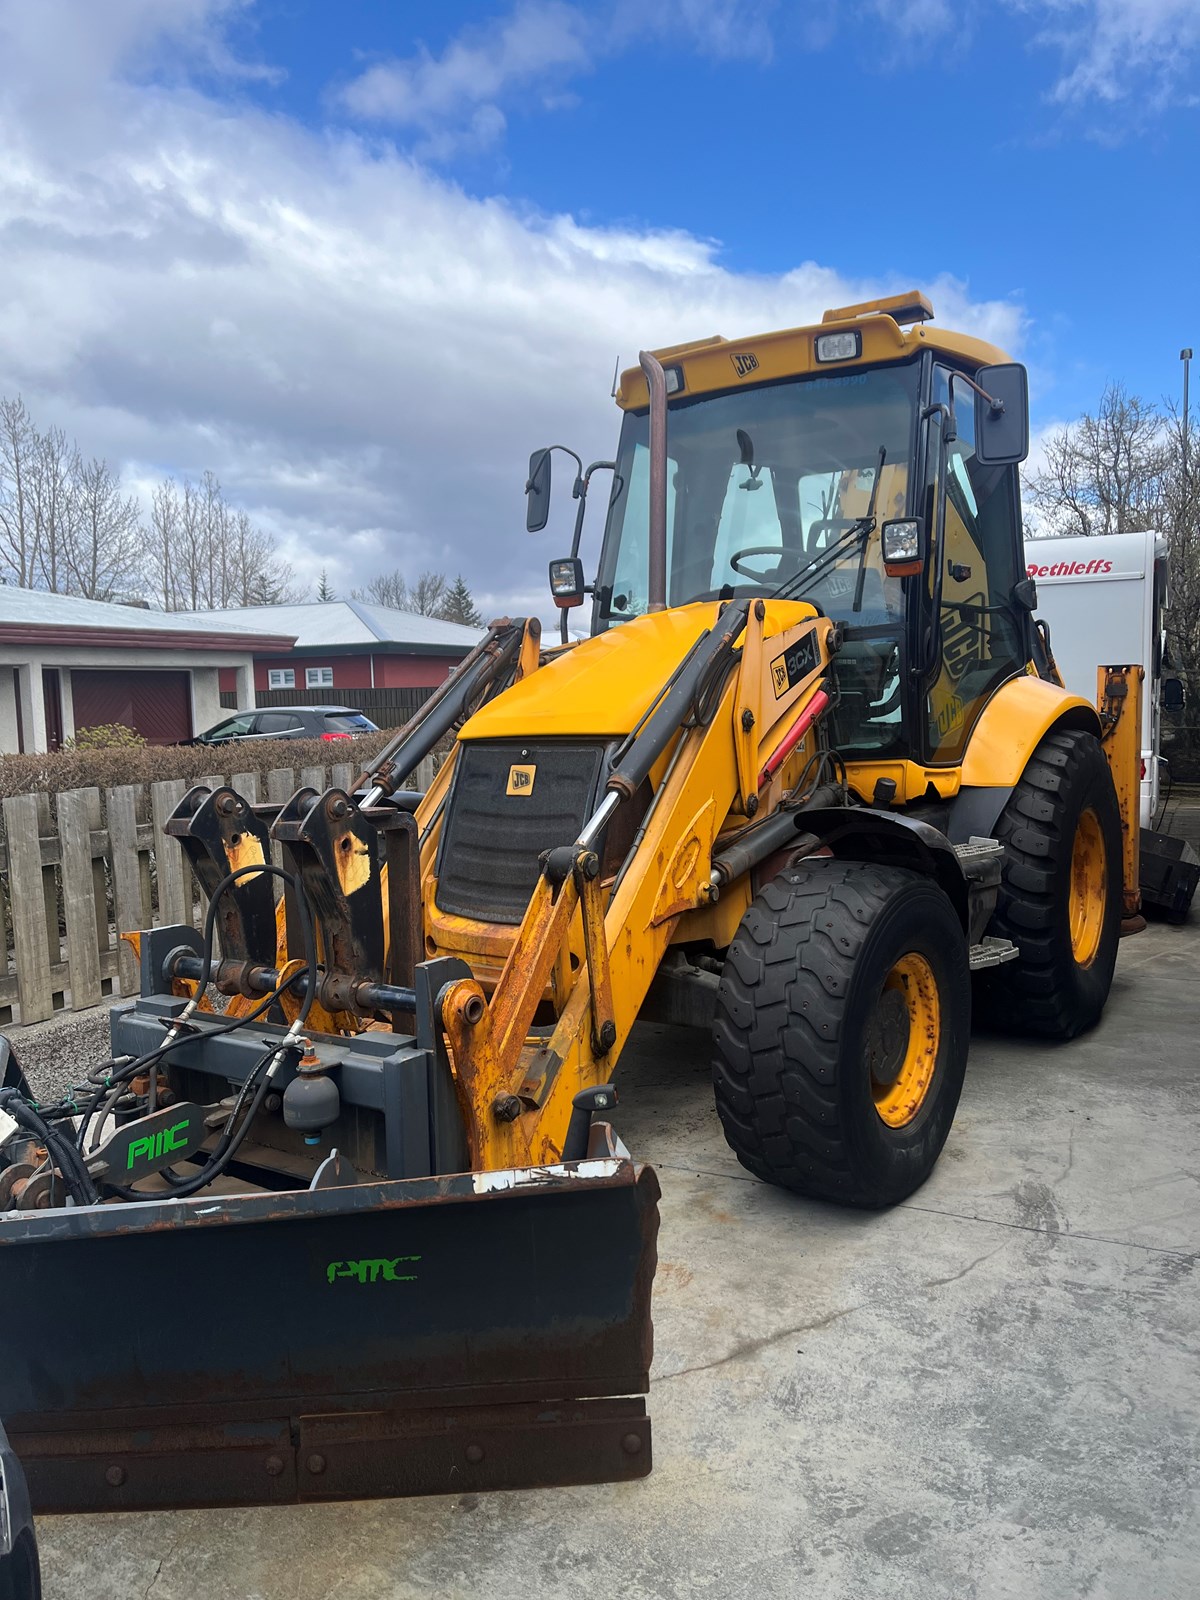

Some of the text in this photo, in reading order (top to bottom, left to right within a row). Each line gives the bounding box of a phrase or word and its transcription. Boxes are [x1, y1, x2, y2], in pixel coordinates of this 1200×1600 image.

[735, 355, 757, 375] JCB
[1026, 559, 1113, 577] Dethleffs
[787, 644, 813, 676] 3CX
[774, 666, 786, 688] JCB
[514, 772, 529, 788] JCB
[127, 1119, 190, 1170] PMC
